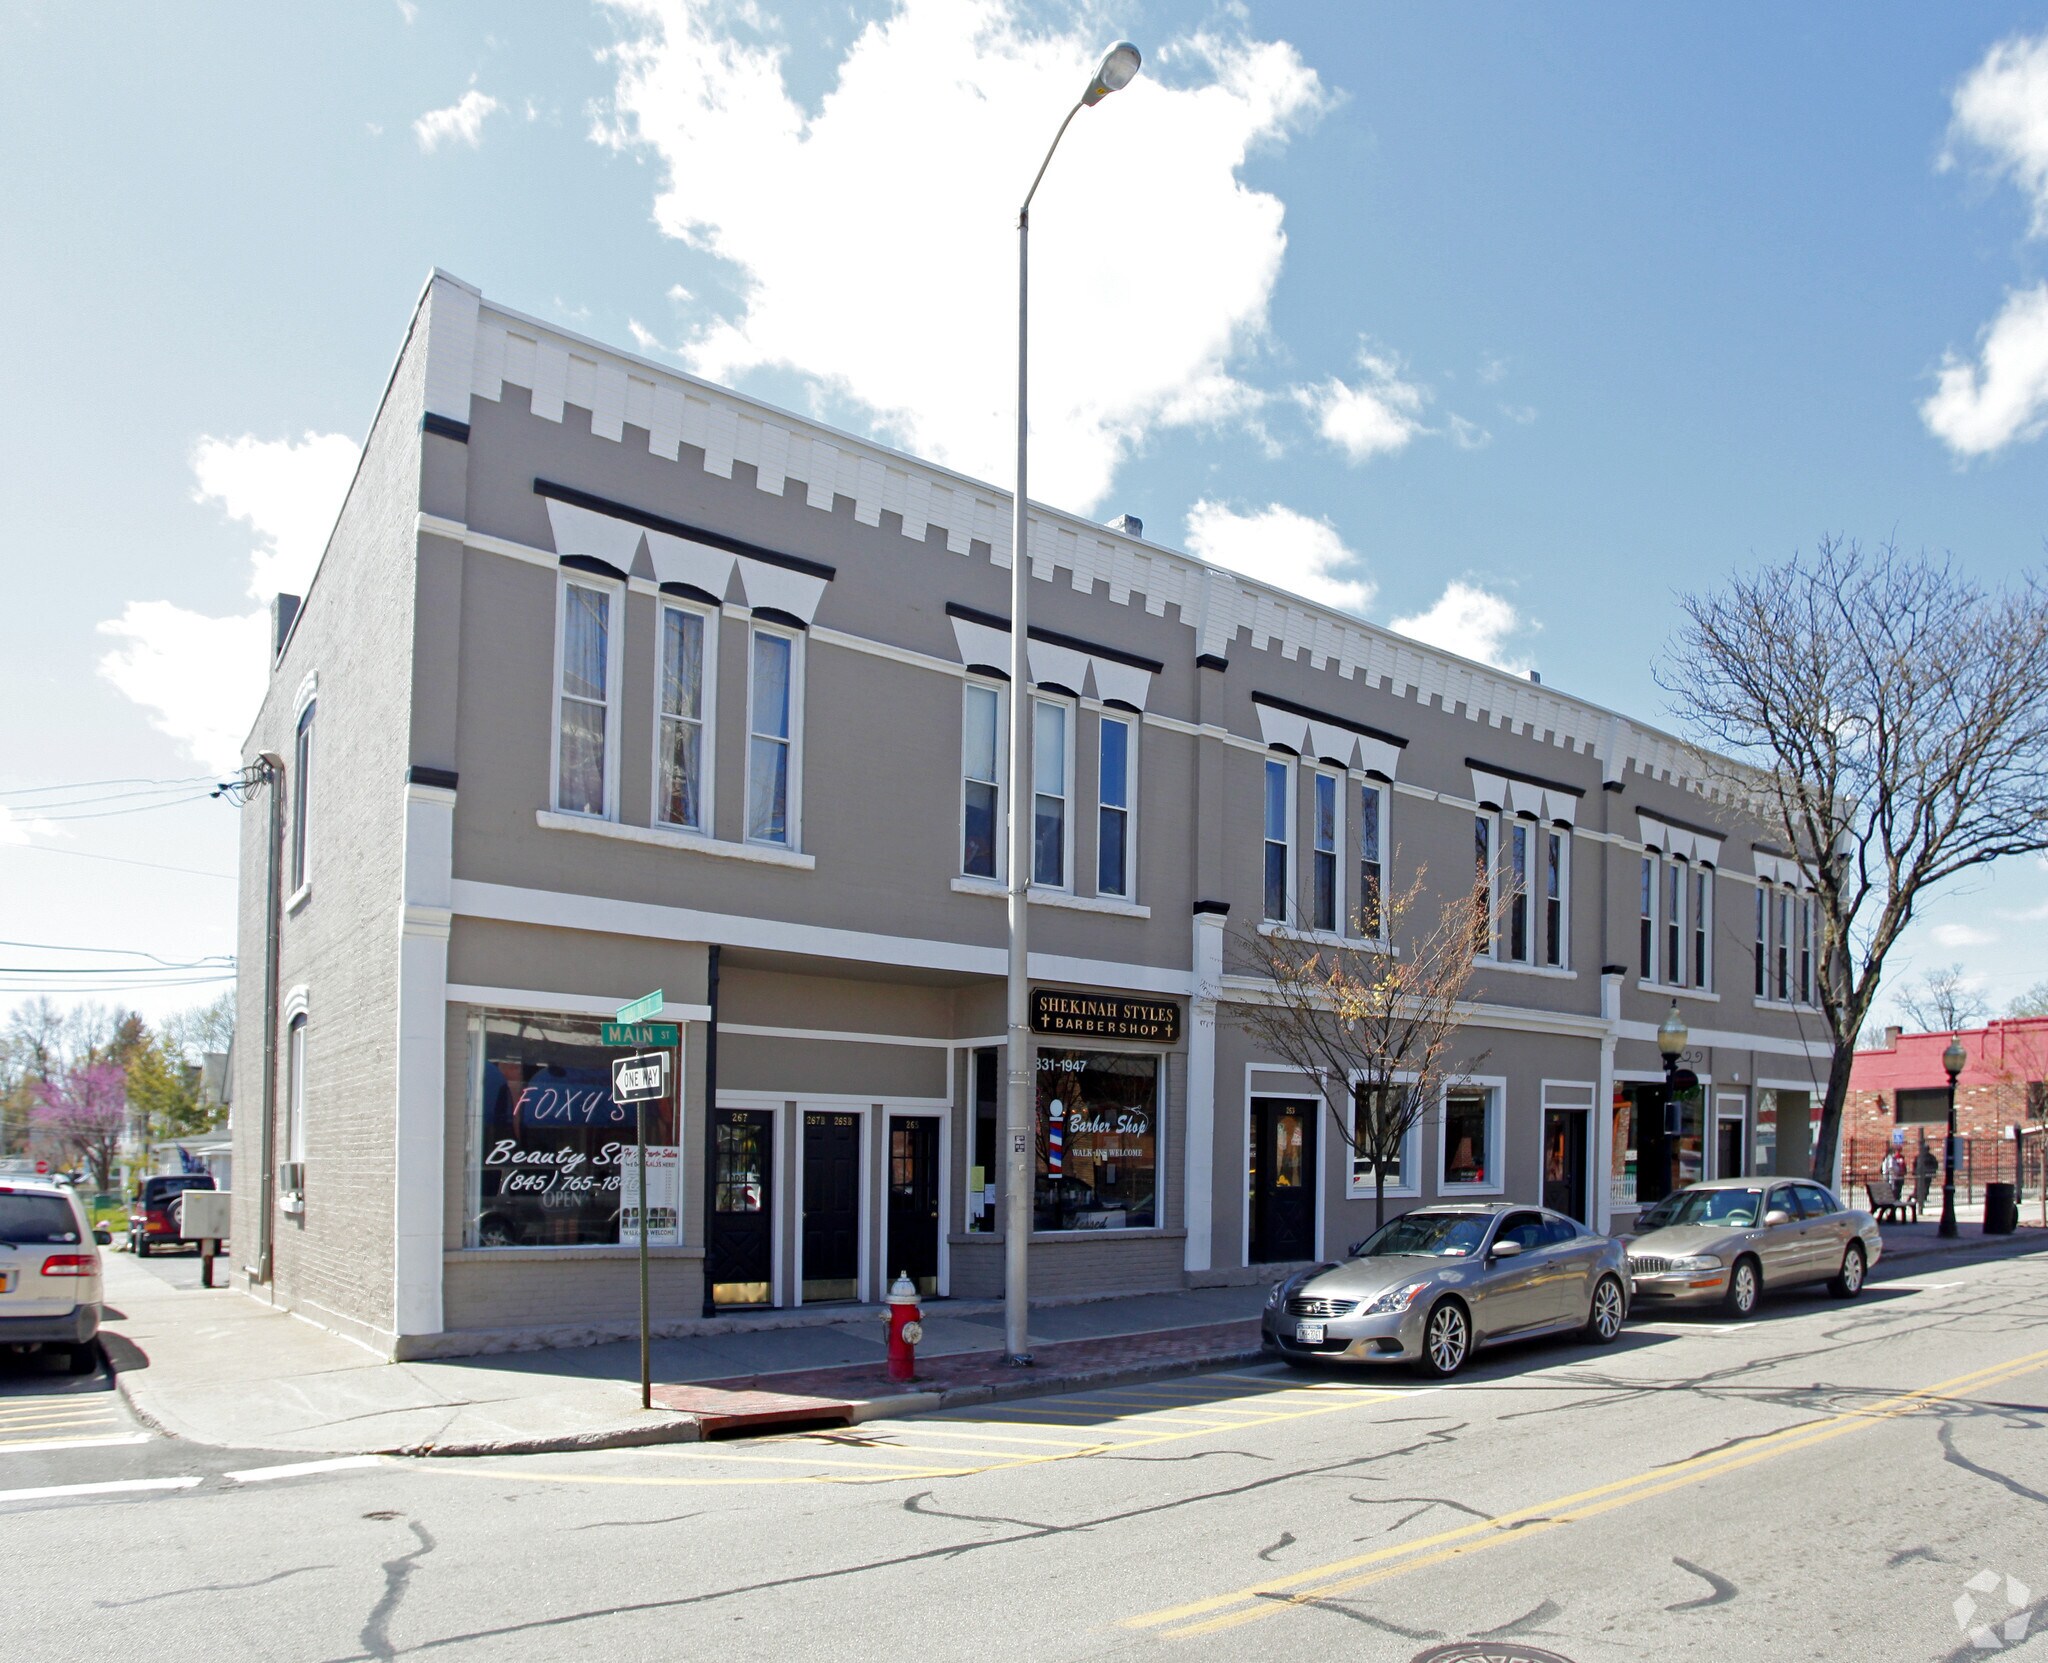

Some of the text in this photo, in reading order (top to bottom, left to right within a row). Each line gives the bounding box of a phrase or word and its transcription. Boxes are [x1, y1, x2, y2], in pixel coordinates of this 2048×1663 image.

[1039, 996, 1174, 1023] SHEKINAH STYLES
[608, 1025, 671, 1043] MAIN ST
[1055, 1017, 1159, 1036] BARBERSHOP
[623, 1067, 659, 1088] ONE WAY
[732, 1112, 748, 1123] 267
[1069, 1113, 1147, 1138] Barber Shop
[485, 1139, 588, 1174] Beauty
[1108, 1148, 1143, 1157] WELCOME
[501, 1170, 558, 1194] (845)
[542, 1191, 582, 1208] OPEN
